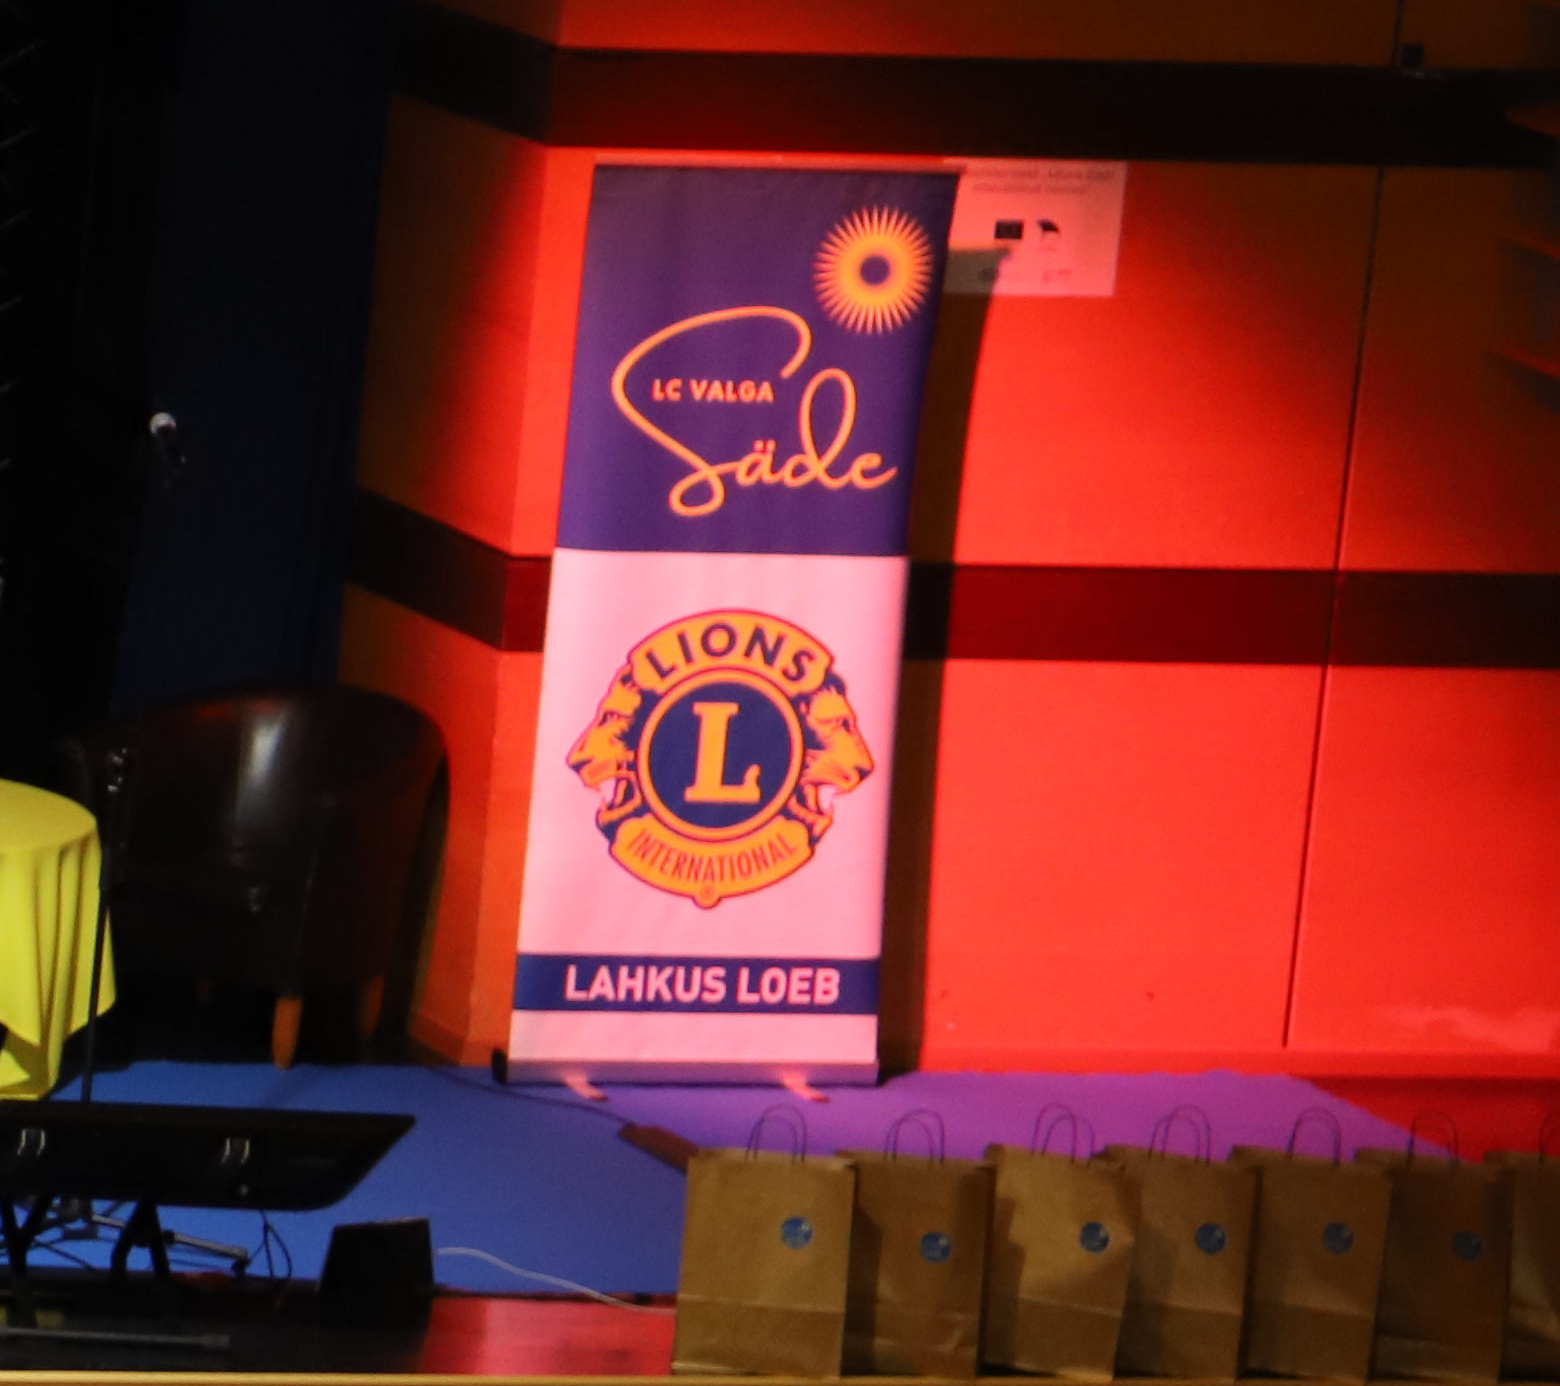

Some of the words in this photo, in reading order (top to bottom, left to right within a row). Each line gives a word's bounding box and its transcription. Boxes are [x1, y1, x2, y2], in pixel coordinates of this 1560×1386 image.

[611, 305, 899, 516] Säde
[651, 378, 682, 401] LC
[689, 379, 775, 403] VALGA
[645, 622, 816, 682] LIONS
[683, 701, 762, 803] L
[627, 828, 798, 882] INTERNATIONAL
[564, 964, 727, 1002] LAHKUS
[736, 966, 841, 1004] LOEB
